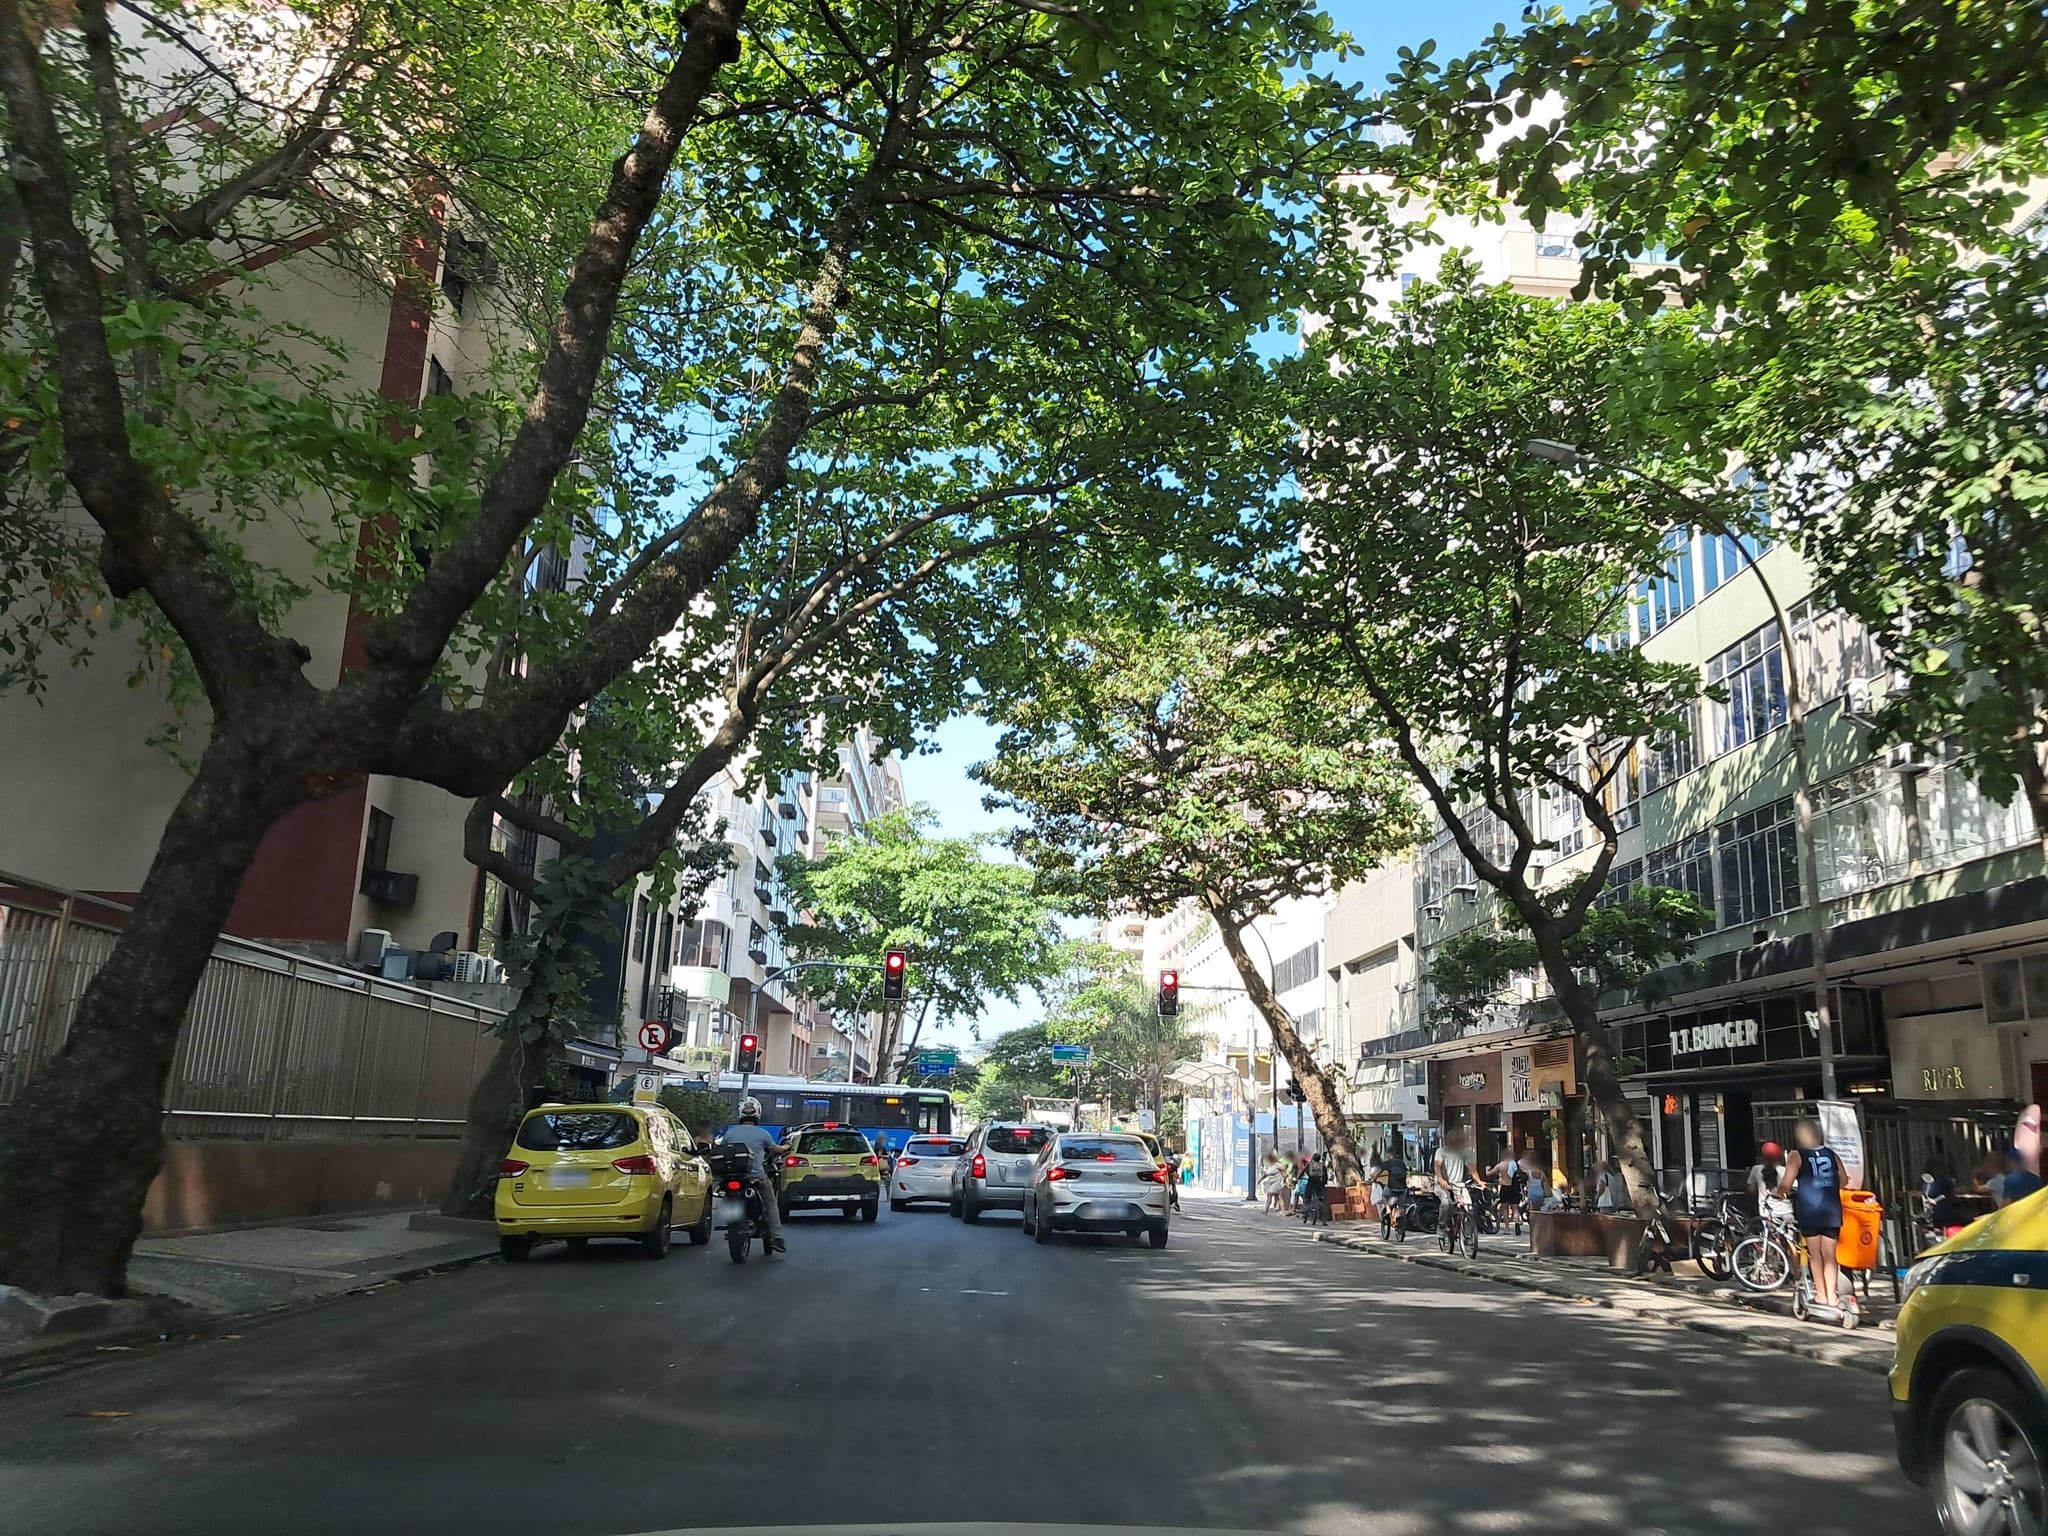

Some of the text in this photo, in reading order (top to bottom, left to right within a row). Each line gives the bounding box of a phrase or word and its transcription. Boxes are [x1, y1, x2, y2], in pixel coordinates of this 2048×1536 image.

[648, 1028, 659, 1044] E
[1921, 1066, 1966, 1091] RIVER
[1511, 1078, 1532, 1103] RIVER
[1808, 1156, 1833, 1178] 12
